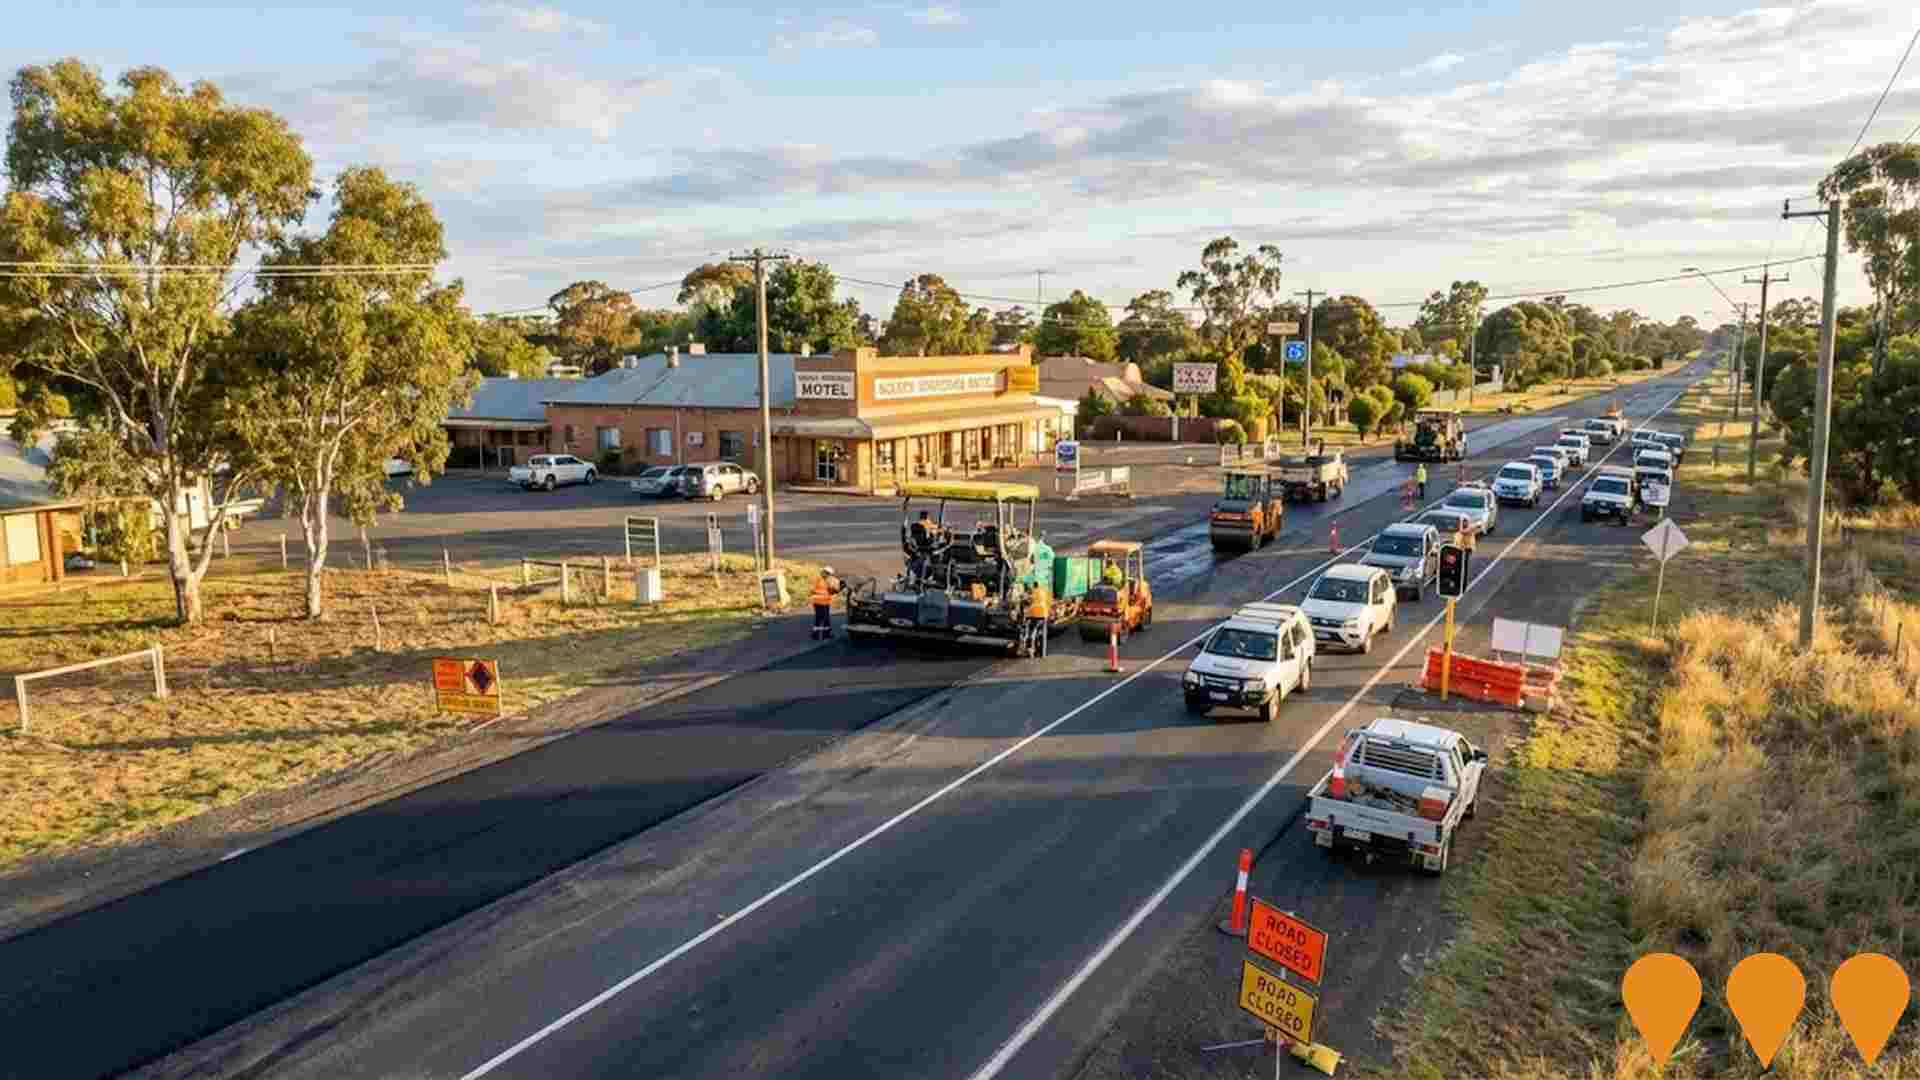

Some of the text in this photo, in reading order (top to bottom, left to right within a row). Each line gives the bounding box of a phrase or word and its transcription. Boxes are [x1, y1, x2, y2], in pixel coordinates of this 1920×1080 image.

[801, 383, 849, 396] MOTEL
[1266, 915, 1307, 945] ROAD
[1256, 931, 1312, 970] CLOSED
[1256, 976, 1297, 1008] ROAD
[1247, 991, 1304, 1032] CLOSED
